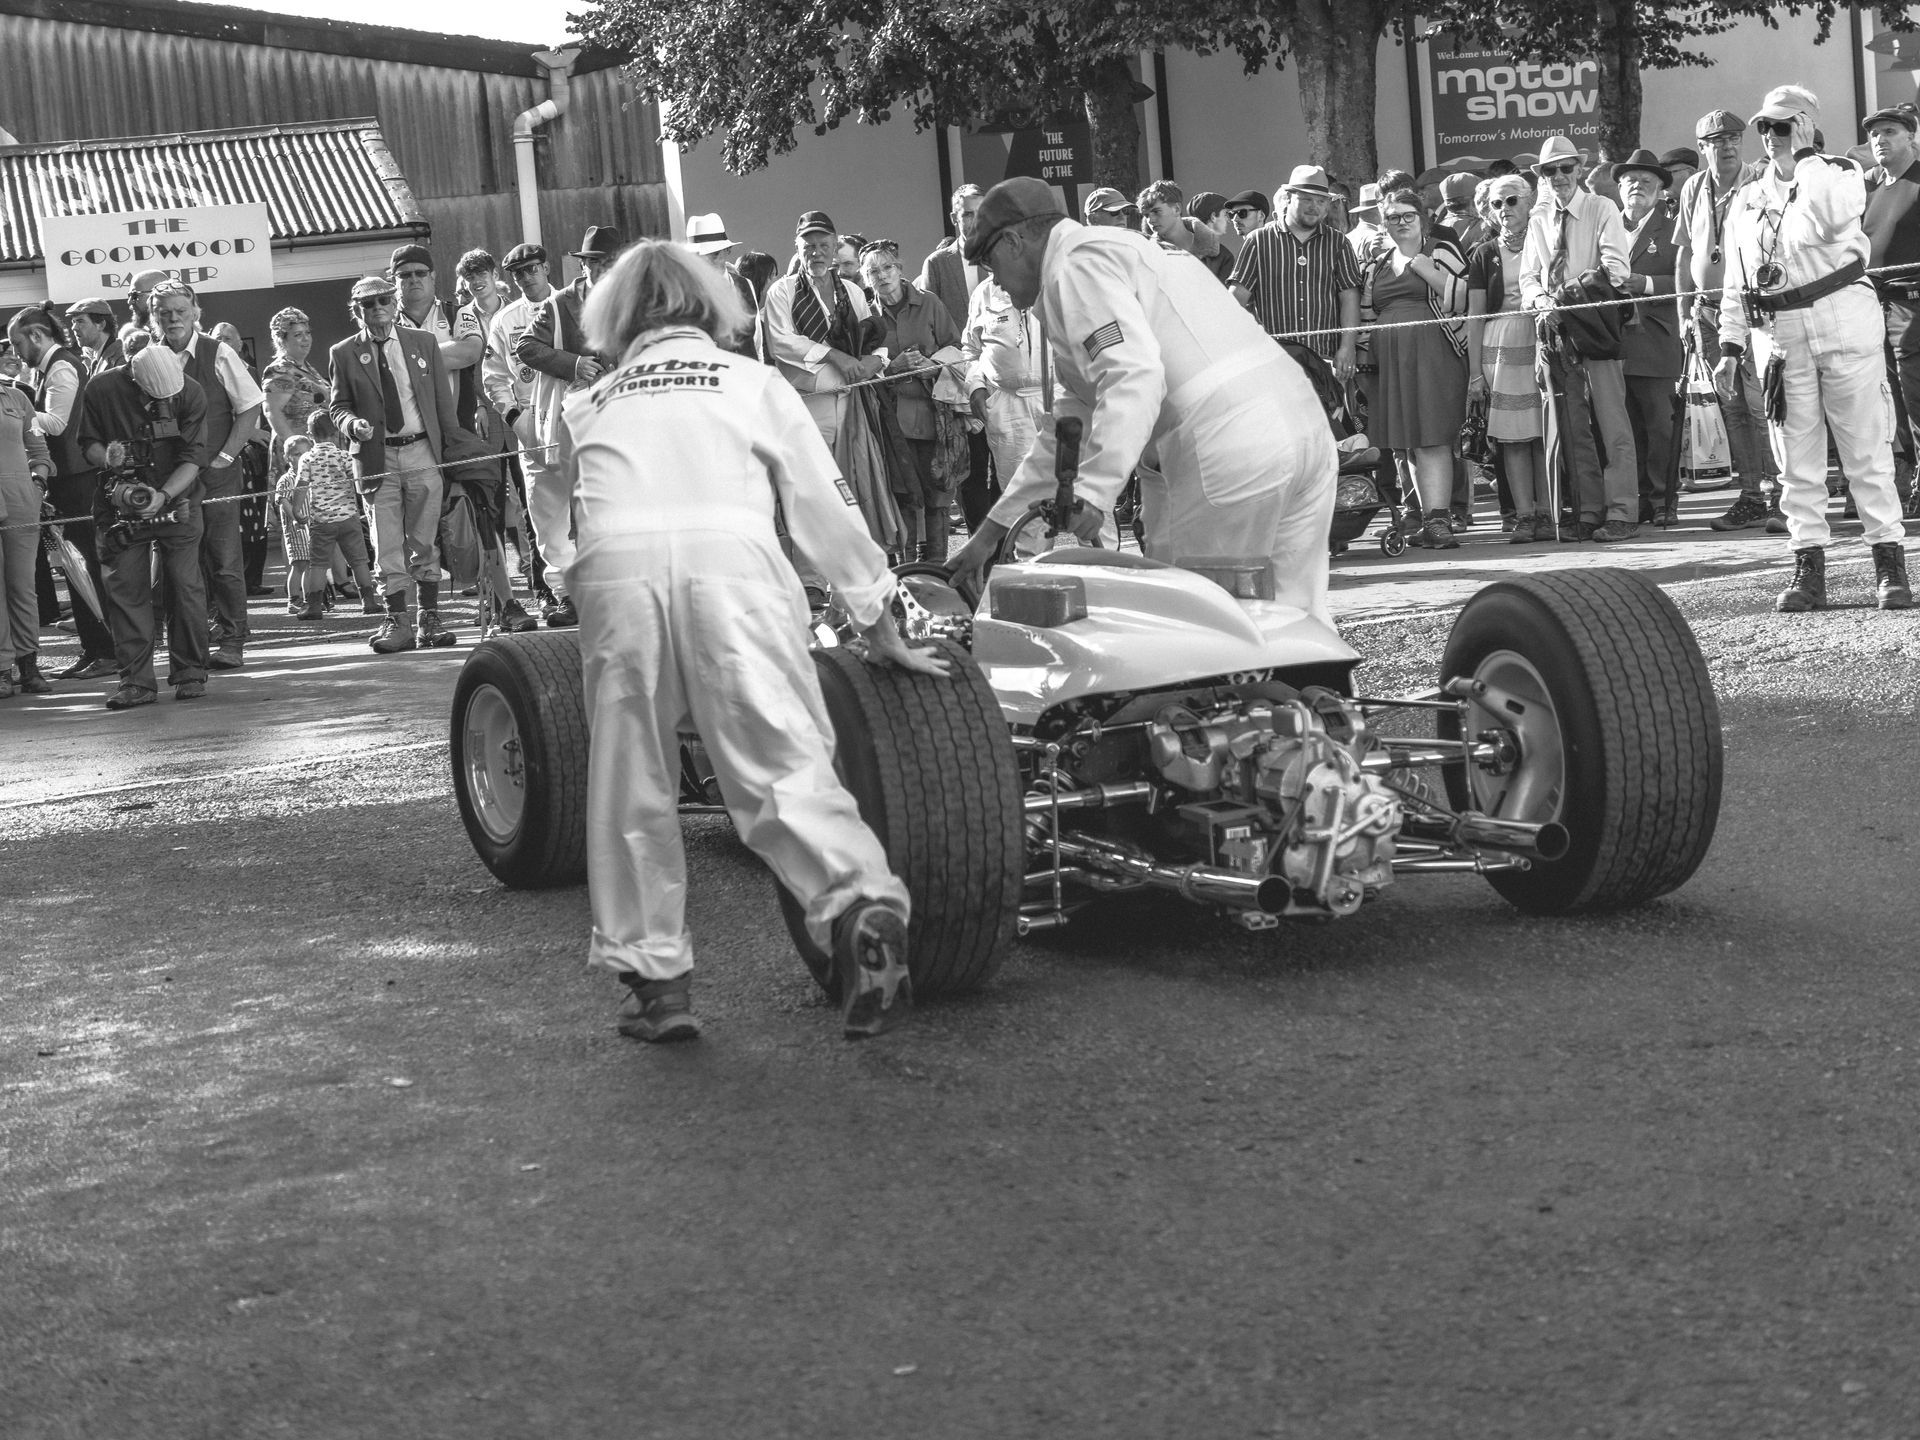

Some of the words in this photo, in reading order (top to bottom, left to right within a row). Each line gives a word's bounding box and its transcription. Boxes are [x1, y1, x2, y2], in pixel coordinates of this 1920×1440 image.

[1437, 60, 1597, 95] motor
[1466, 88, 1599, 121] show
[1045, 131, 1064, 145] THE
[1437, 129, 1506, 145] Tomorrow's
[1510, 125, 1564, 139] Motoring
[1039, 147, 1074, 162] FUTURE
[1042, 166, 1054, 179] OF
[1055, 164, 1073, 178] THE
[122, 218, 190, 236] THE
[60, 237, 256, 267] GOODWOOD
[101, 266, 218, 288] BABER
[599, 376, 720, 403] TORSPORTS
